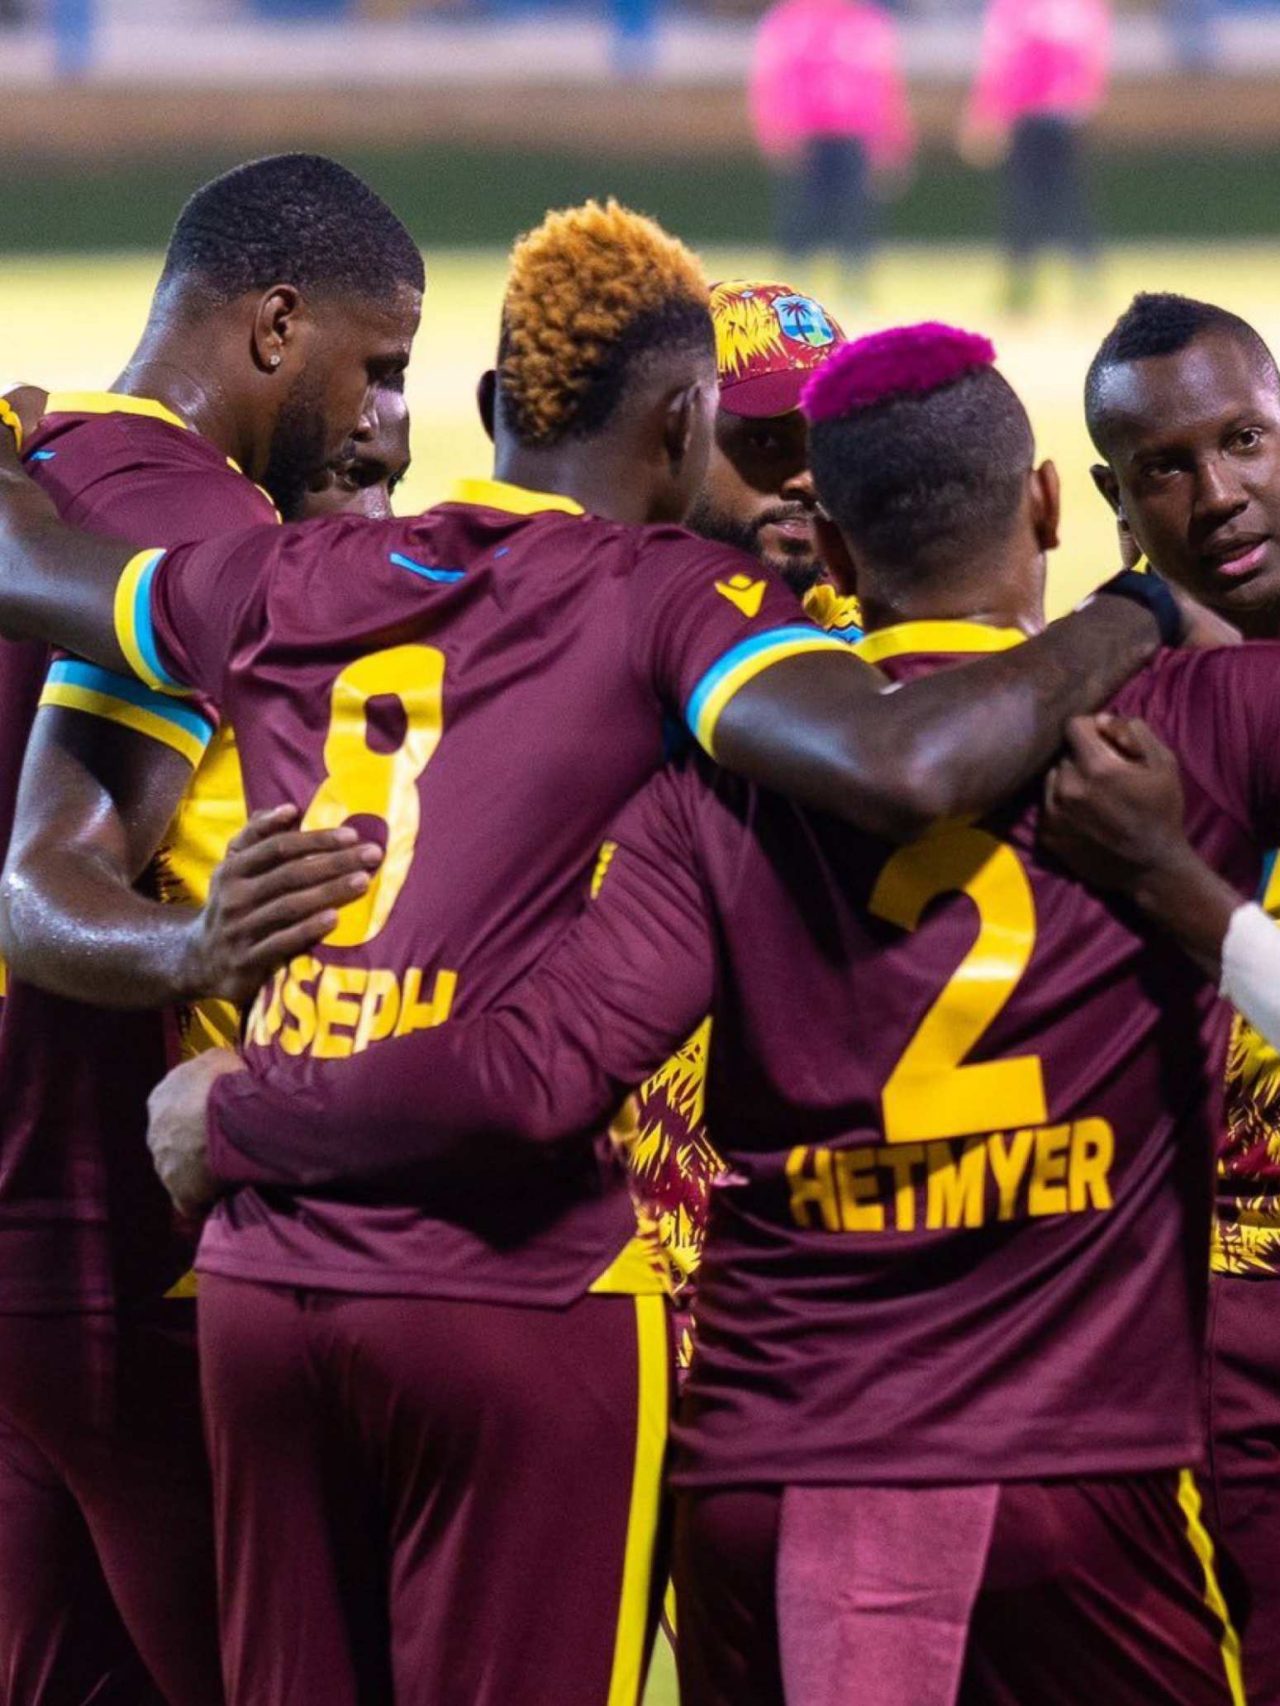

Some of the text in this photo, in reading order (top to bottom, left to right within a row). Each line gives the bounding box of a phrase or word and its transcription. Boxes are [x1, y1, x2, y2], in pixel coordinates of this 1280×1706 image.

[300, 643, 446, 947] 8
[244, 954, 459, 1059] OSEPH
[867, 812, 1048, 1144] 2
[784, 1116, 1115, 1233] HETMYER
